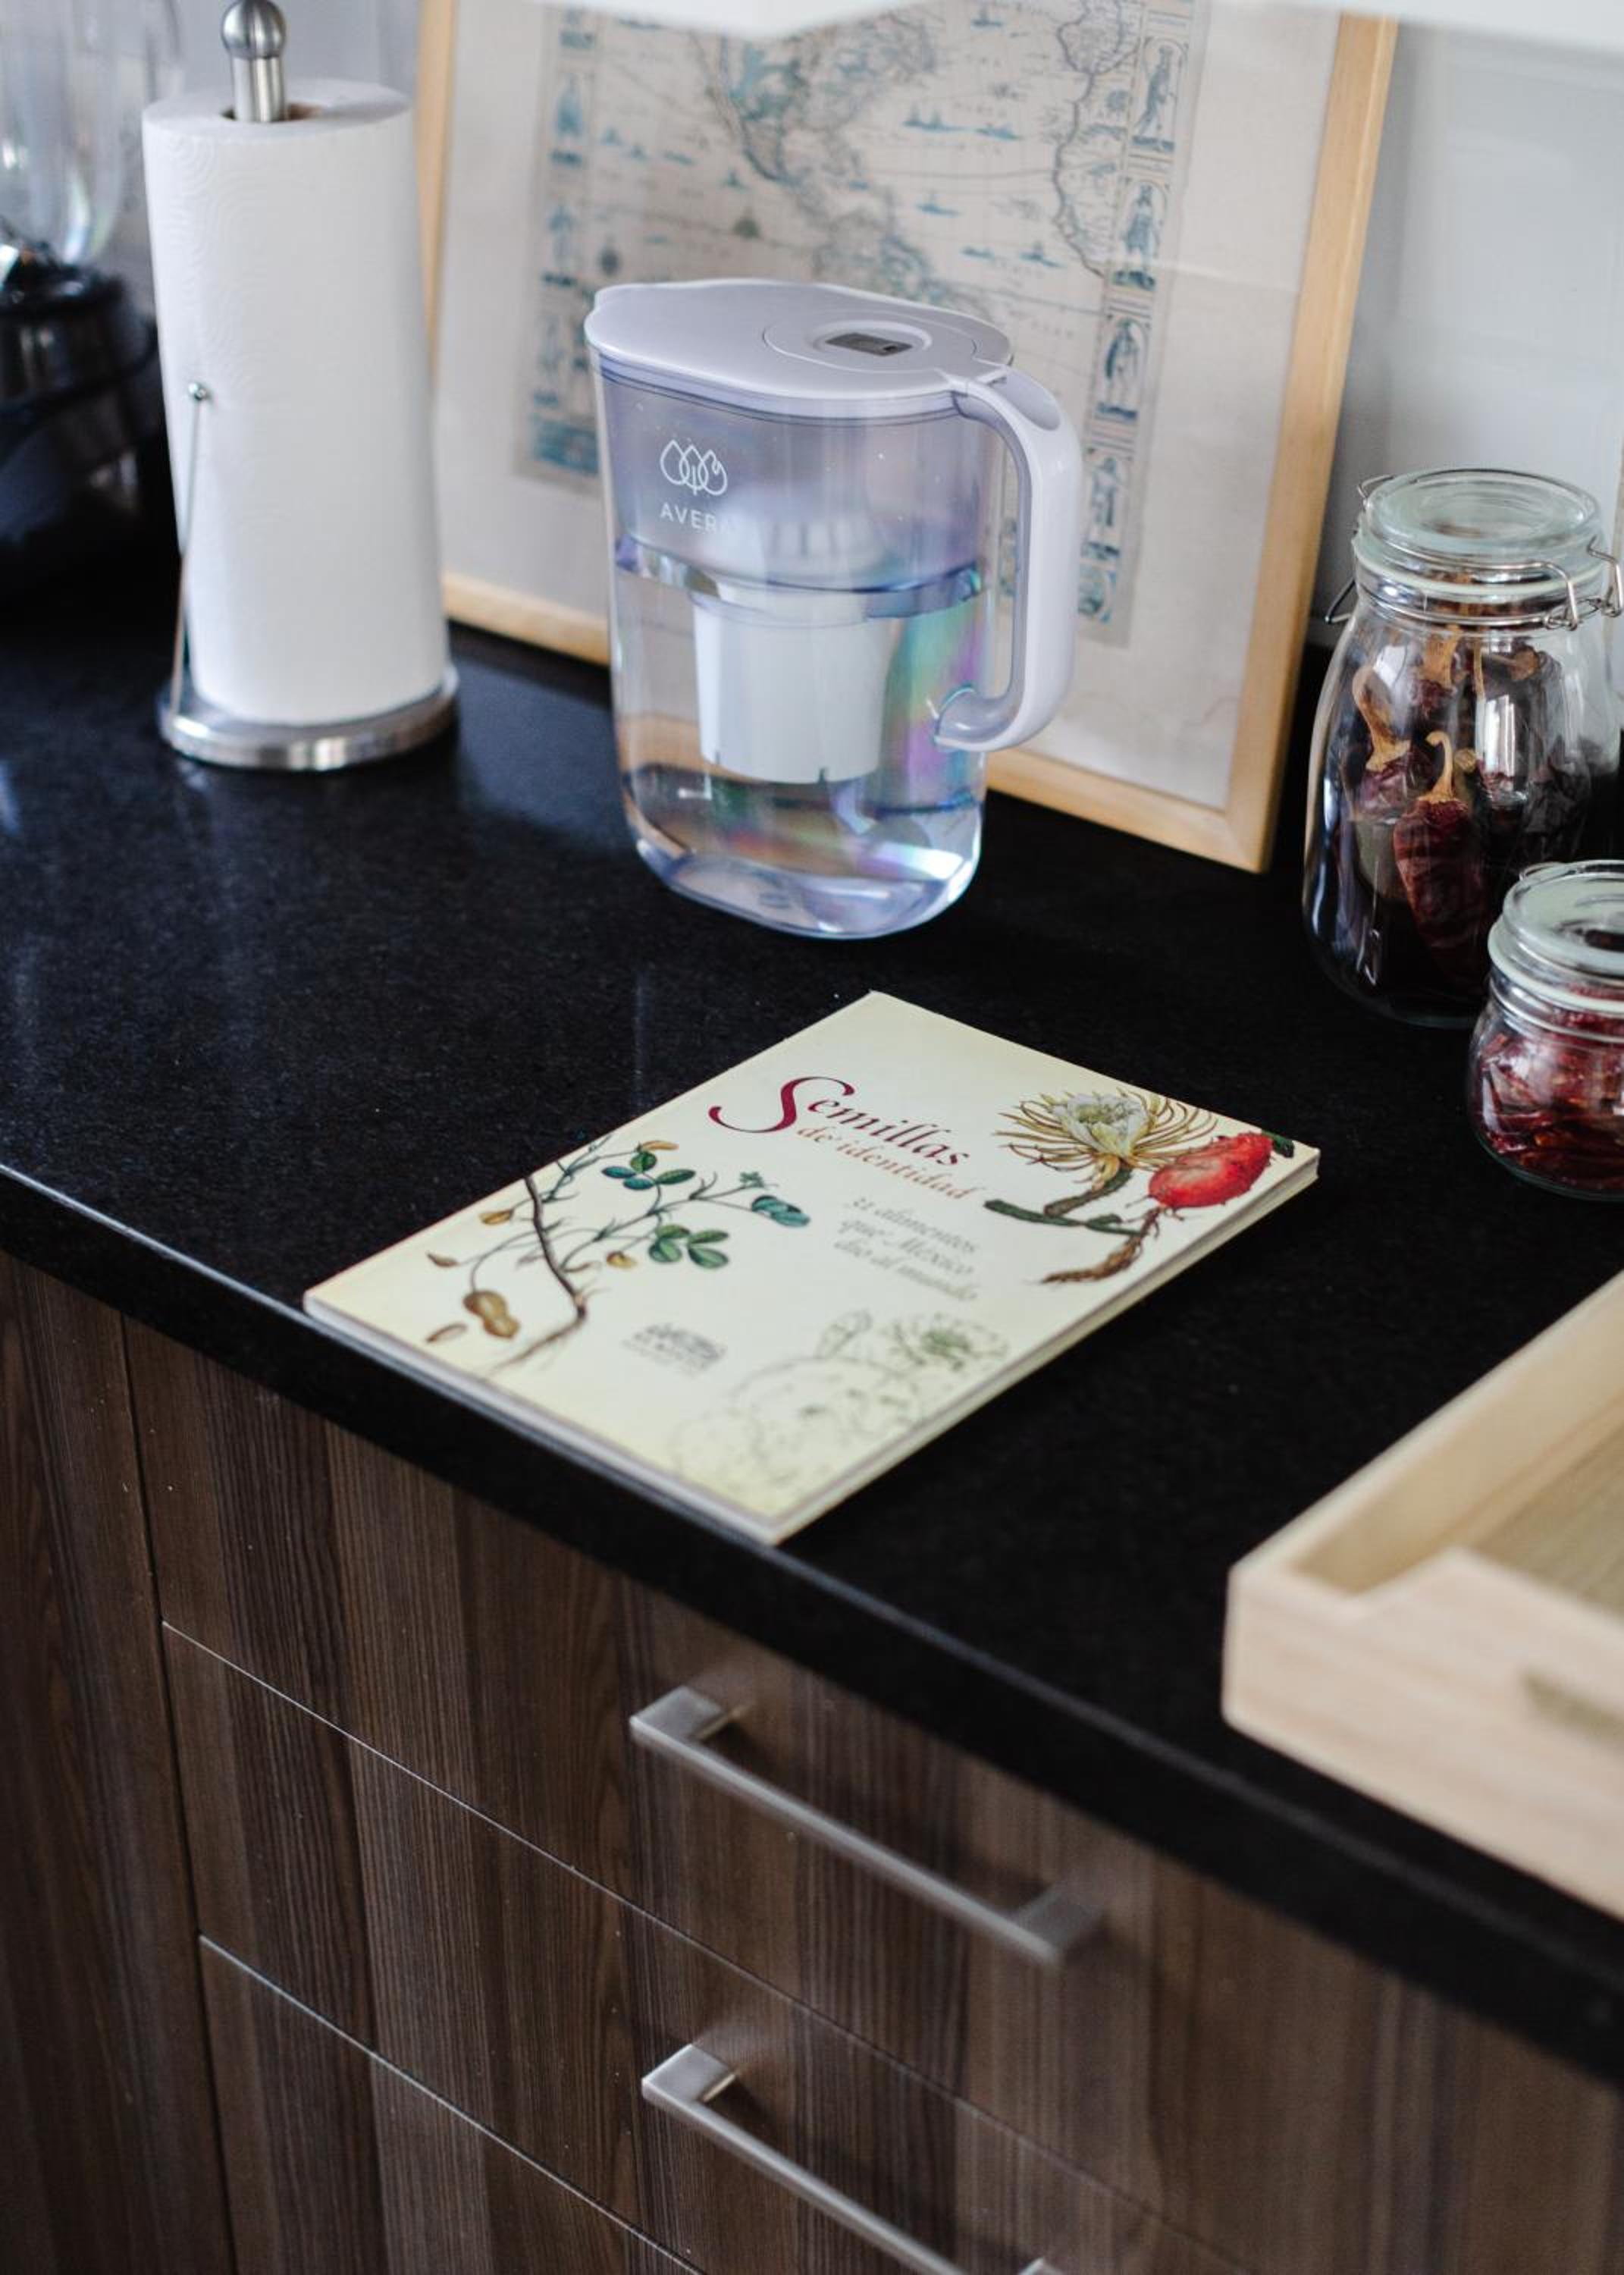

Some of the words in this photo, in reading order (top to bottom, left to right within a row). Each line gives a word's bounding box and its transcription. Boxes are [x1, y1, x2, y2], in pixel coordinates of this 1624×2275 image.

[708, 1077, 970, 1166] Semillas
[797, 1125, 841, 1144] de
[836, 1141, 983, 1199] identidad
